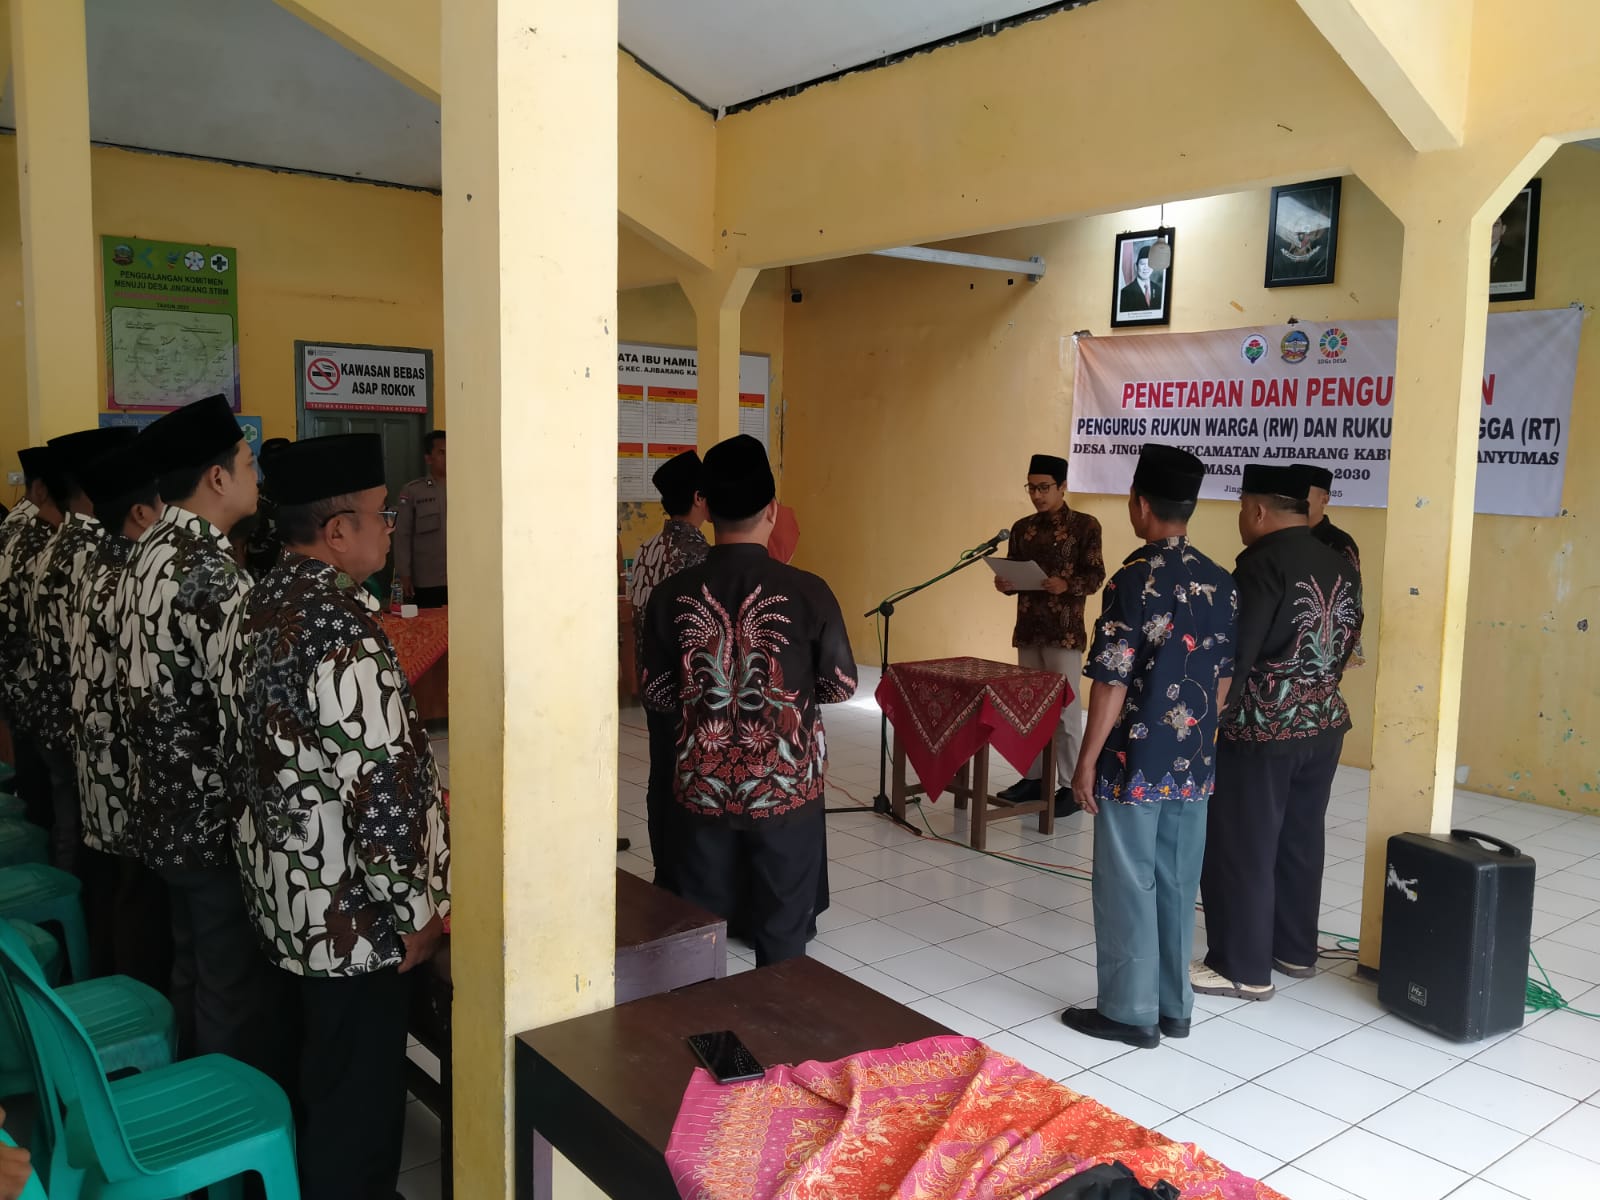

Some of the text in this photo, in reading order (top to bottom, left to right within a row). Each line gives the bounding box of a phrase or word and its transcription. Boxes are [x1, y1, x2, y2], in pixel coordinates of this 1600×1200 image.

[114, 280, 146, 289] MENUJU
[148, 283, 168, 291] DESA
[120, 270, 223, 286] PENGGALANGAN KOMITMEN
[617, 353, 697, 368] ATA IBU HAMIL
[341, 363, 425, 380] KAWASAN BEBAS
[644, 367, 685, 376] AJIBARANG
[352, 382, 416, 397] ASAP ROKOK
[1121, 376, 1394, 409] PENETAPAN DAN PENGU
[1077, 417, 1147, 436] PENGURUS
[1150, 417, 1201, 437] RUKUN
[1205, 417, 1258, 438] WARGA
[1263, 417, 1299, 442] (RW)
[1303, 417, 1337, 438] DAN
[1342, 417, 1393, 439] RUKU
[1521, 417, 1561, 446] (RT)
[1073, 443, 1106, 454] DESA
[1109, 444, 1143, 455] JING
[1263, 447, 1349, 460] AJIBARANG
[1354, 448, 1391, 461] KAB
[1477, 450, 1560, 465] ANYUMAS
[1203, 464, 1371, 480] MASA 2030
[1224, 485, 1242, 494] Jing
